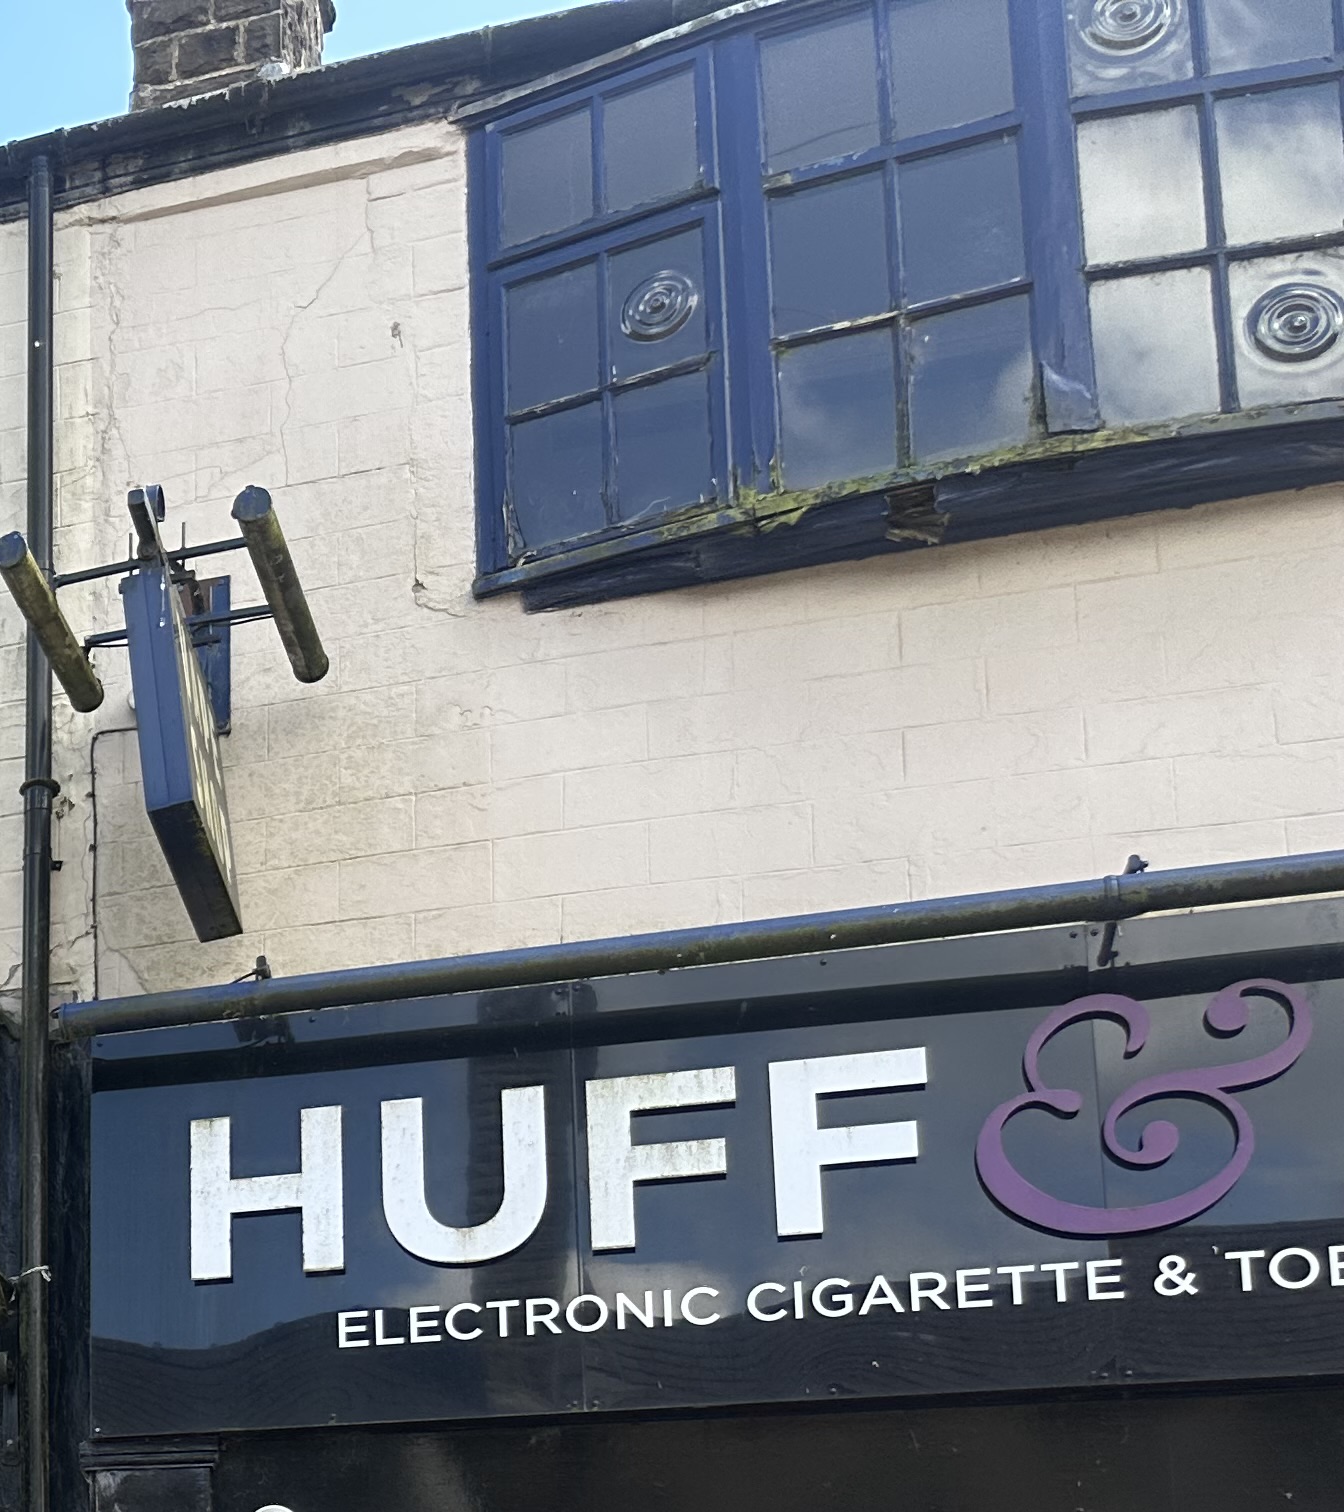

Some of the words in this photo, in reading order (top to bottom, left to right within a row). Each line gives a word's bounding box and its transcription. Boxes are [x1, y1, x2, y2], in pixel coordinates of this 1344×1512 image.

[190, 1046, 928, 1281] HUFF
[975, 977, 1313, 1239] &
[337, 1284, 721, 1348] ELECTRONIC
[746, 1258, 1125, 1323] CIGARETTE
[1153, 1253, 1199, 1297] &
